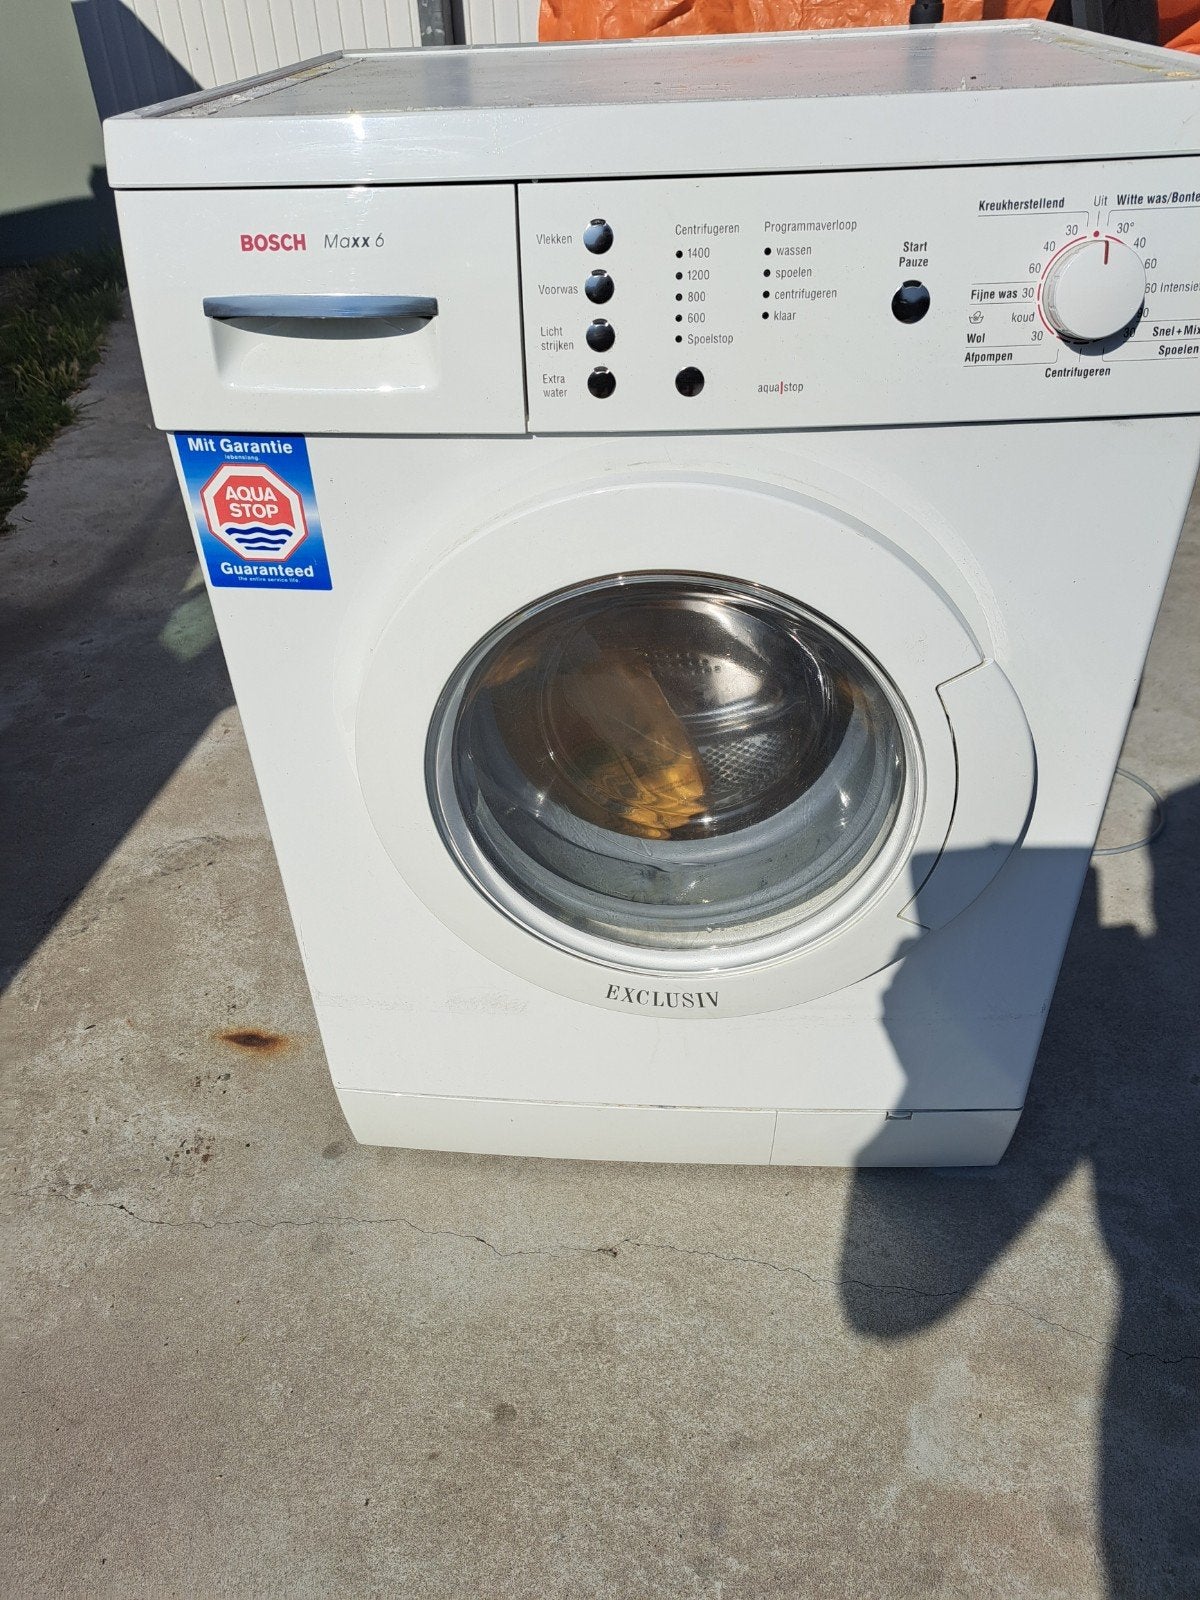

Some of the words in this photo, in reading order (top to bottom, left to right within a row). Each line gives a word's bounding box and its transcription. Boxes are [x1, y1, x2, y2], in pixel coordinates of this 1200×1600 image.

[978, 197, 1065, 211] Kreukherstellend
[1093, 194, 1108, 207] Uit
[1116, 193, 1144, 206] Witte
[675, 223, 740, 236] Centrifugeren
[764, 219, 858, 234] Programmaverloop
[1065, 224, 1079, 236] 30
[1116, 221, 1135, 234] 30°
[240, 233, 307, 252] BOSCH
[323, 233, 371, 248] Maxx
[375, 232, 385, 248] 6
[535, 233, 573, 245] Vlekken
[1133, 236, 1147, 249] 40
[776, 245, 812, 256] wassen
[902, 240, 928, 253] Start
[1043, 240, 1056, 252] 40
[687, 247, 711, 259] 1400
[898, 256, 929, 268] Pauze
[1028, 262, 1042, 274] 60
[1144, 257, 1158, 270] 60
[687, 269, 711, 281] 1200
[775, 267, 813, 280] spoelen
[537, 284, 579, 295] Voorwas
[1144, 282, 1158, 294] 60
[1159, 280, 1200, 293] Intensie
[687, 291, 706, 302] 800
[774, 287, 838, 301] centrifugeren
[970, 289, 996, 302] Fijne
[998, 290, 1018, 299] was
[1021, 287, 1035, 299] 30
[687, 312, 706, 323] 600
[773, 310, 797, 321] klaar
[1011, 311, 1036, 323] koud
[540, 326, 564, 337] Licht
[966, 333, 986, 344] Wol
[1030, 330, 1044, 342] 30
[1123, 326, 1136, 338] 30
[540, 340, 575, 352] strijken
[687, 333, 734, 346] Spoelstop
[1158, 344, 1200, 357] Spoelen
[964, 351, 1013, 364] Afpompen
[542, 373, 566, 384] Extra
[1044, 366, 1111, 379] Centrifugeren
[542, 388, 568, 398] water
[187, 437, 217, 452] Mit
[219, 438, 293, 454] Garantie
[225, 485, 278, 502] AQUA
[229, 503, 279, 519] STOP
[220, 561, 315, 578] Guaranteed
[605, 983, 719, 1009] EXCLUSIV
